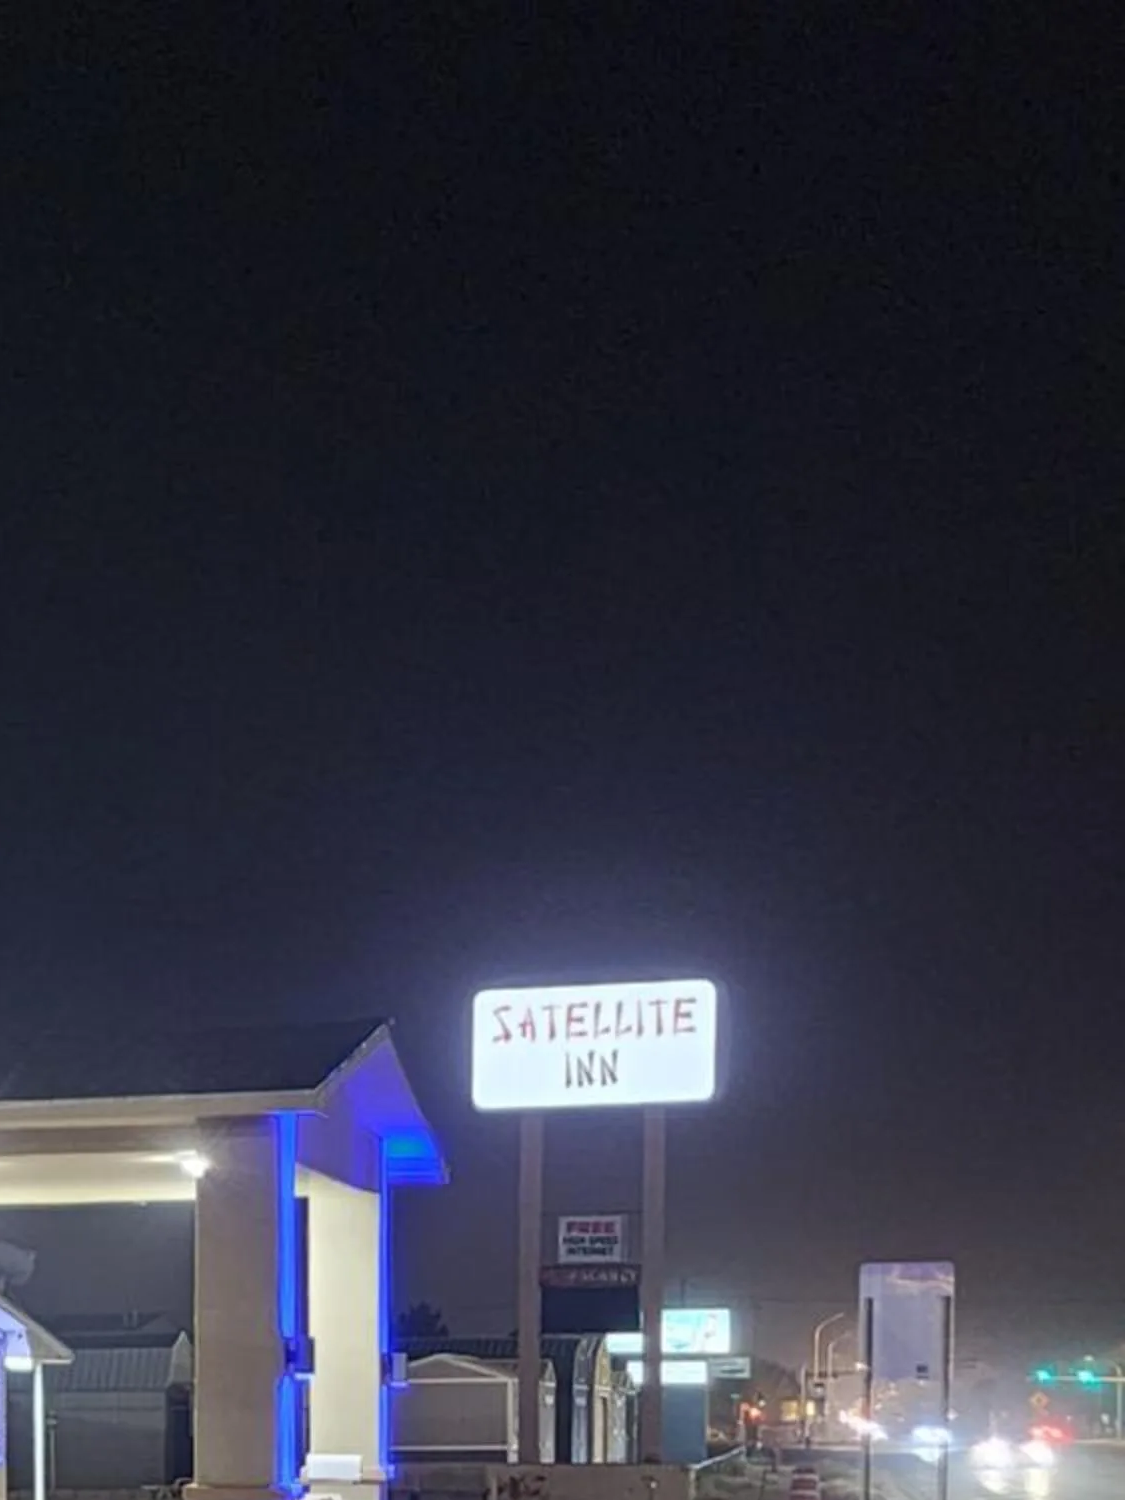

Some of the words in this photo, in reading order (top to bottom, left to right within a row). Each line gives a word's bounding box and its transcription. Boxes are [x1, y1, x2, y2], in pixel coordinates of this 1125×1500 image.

[492, 998, 698, 1043] SATELLITE
[565, 1049, 619, 1088] INN
[566, 1221, 615, 1233] FREE
